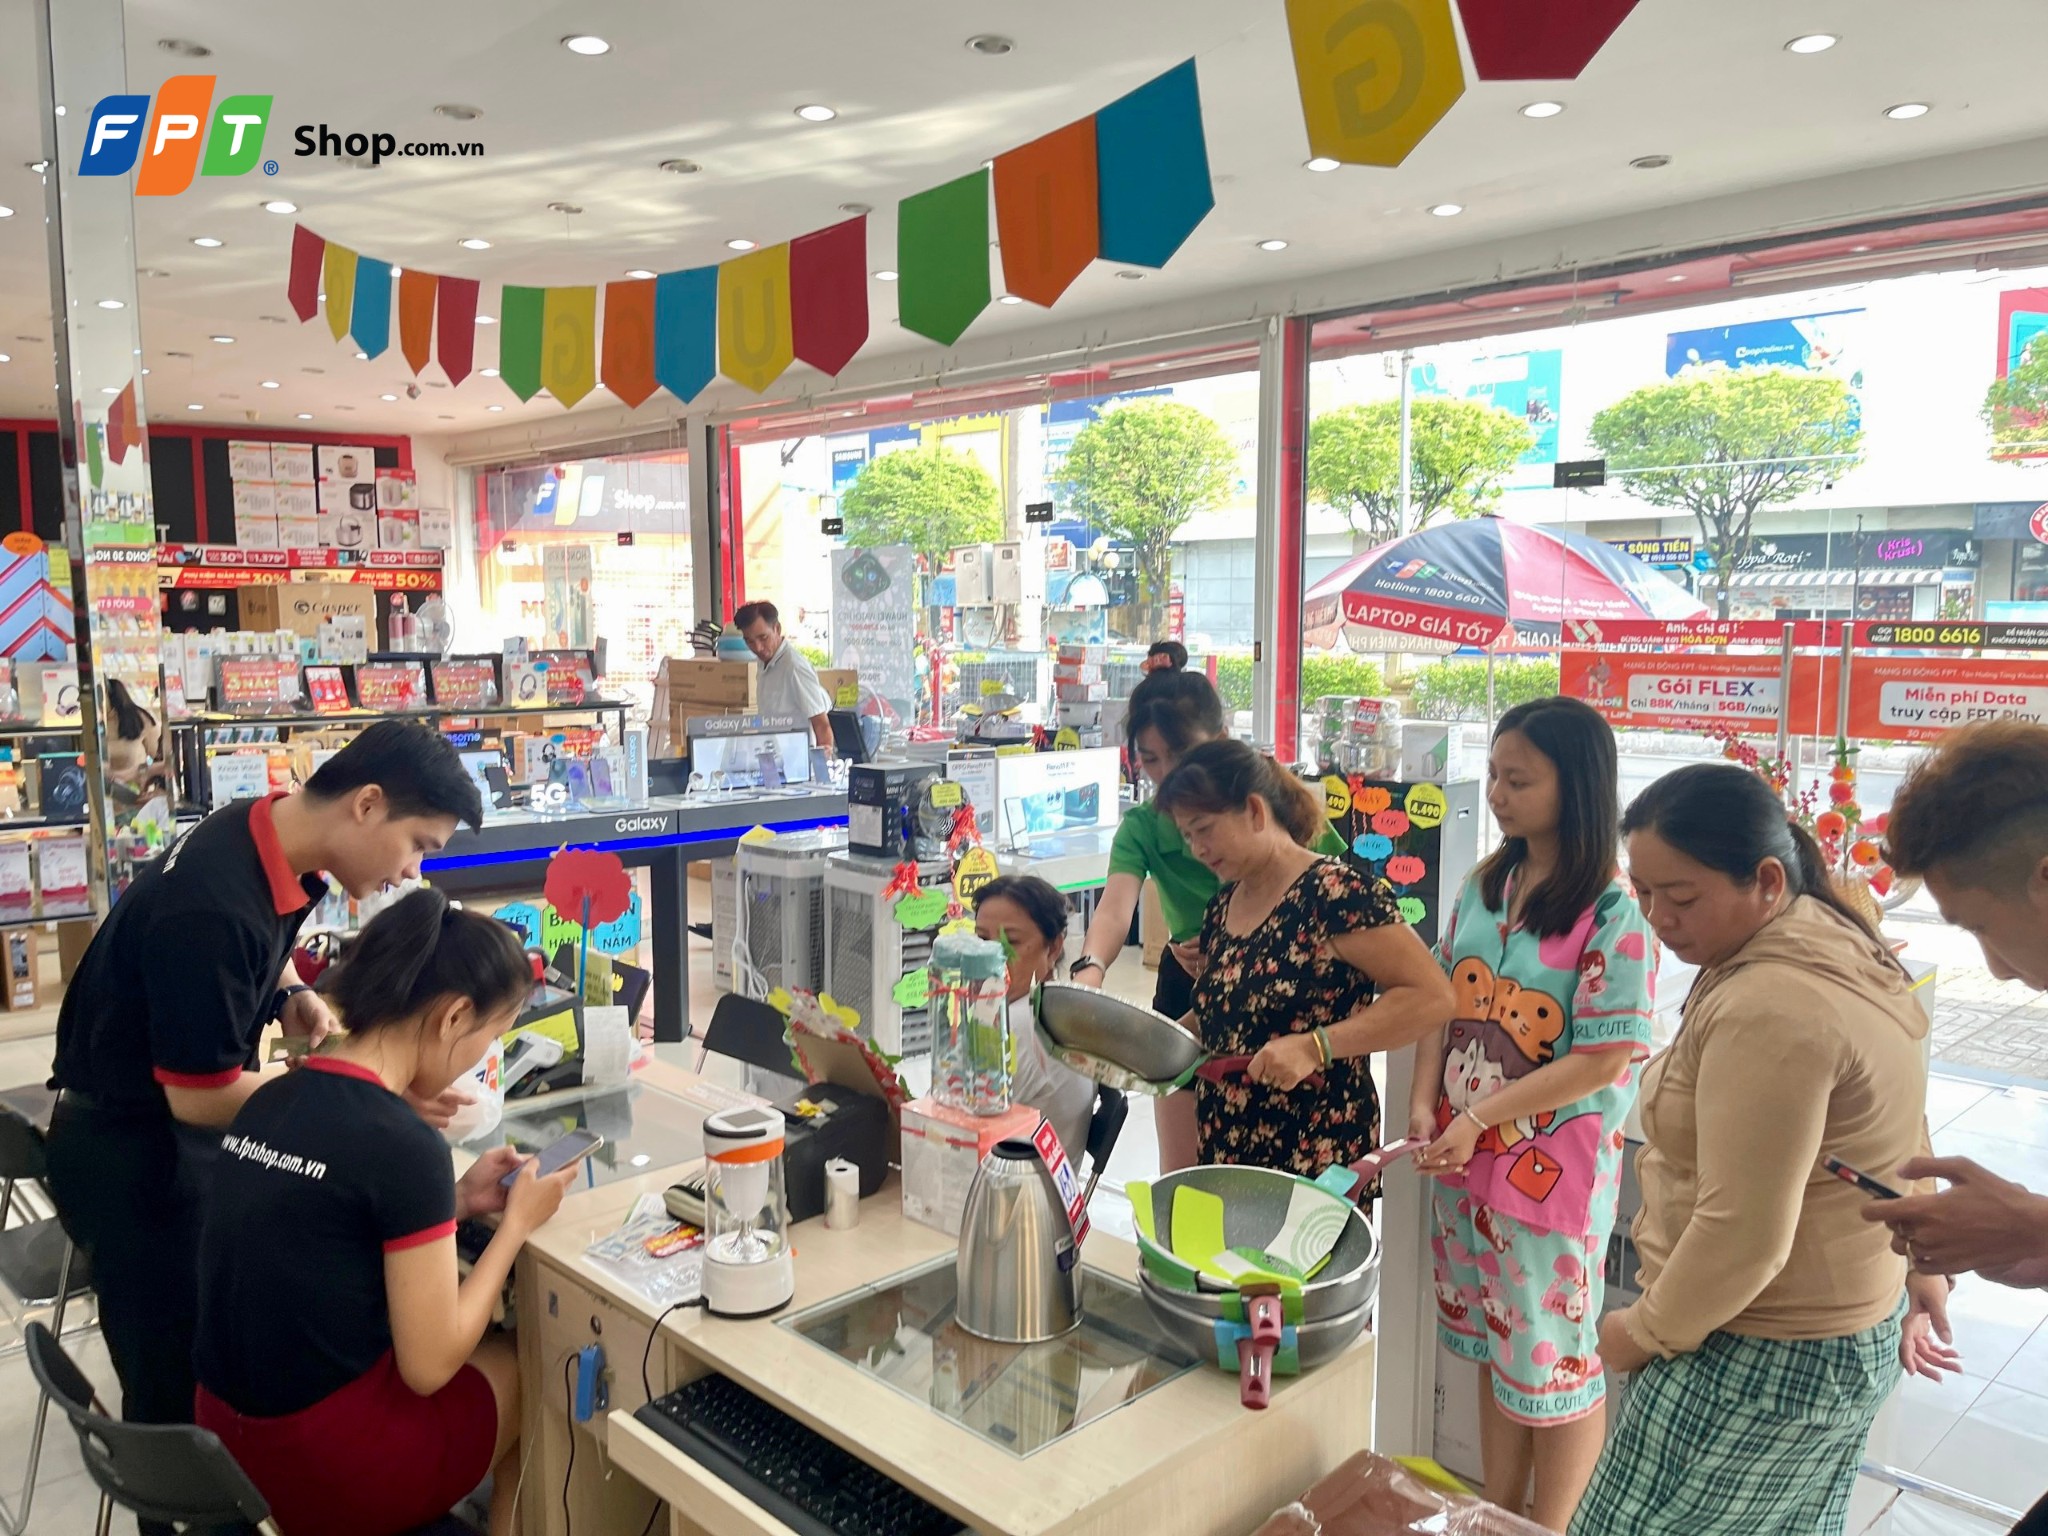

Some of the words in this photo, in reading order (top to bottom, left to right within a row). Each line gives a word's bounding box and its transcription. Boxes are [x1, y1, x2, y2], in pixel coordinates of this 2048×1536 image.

[396, 574, 436, 588] 50%
[1375, 578, 1420, 595] Hotline:
[1424, 587, 1453, 600] 1800
[1454, 592, 1486, 606] 6601
[312, 601, 360, 615] Casper
[1347, 603, 1417, 628] LAPTOP
[1419, 616, 1452, 637] GIÁ
[1455, 618, 1493, 643] TỐT
[1666, 622, 1693, 634] Anh,
[1893, 627, 1935, 643] 1800
[1938, 627, 1981, 644] 6616
[1657, 679, 1692, 695] Gói
[1699, 680, 1754, 697] FLEX
[1905, 686, 1945, 702] Miễn
[1950, 689, 1978, 707] phí
[1982, 691, 2027, 706] Data
[705, 719, 740, 731] Galaxy
[771, 715, 794, 727] here
[1891, 706, 1924, 721] truy
[1929, 707, 1961, 723] cập
[1966, 709, 1998, 721] FPT
[530, 782, 568, 806] 5G
[1410, 801, 1441, 818] 4.490
[614, 815, 669, 833] Galaxy
[612, 923, 624, 932] 12
[602, 934, 632, 949] NĂM
[1597, 1020, 1633, 1038] CUTE
[1518, 1398, 1554, 1414] GIRL
